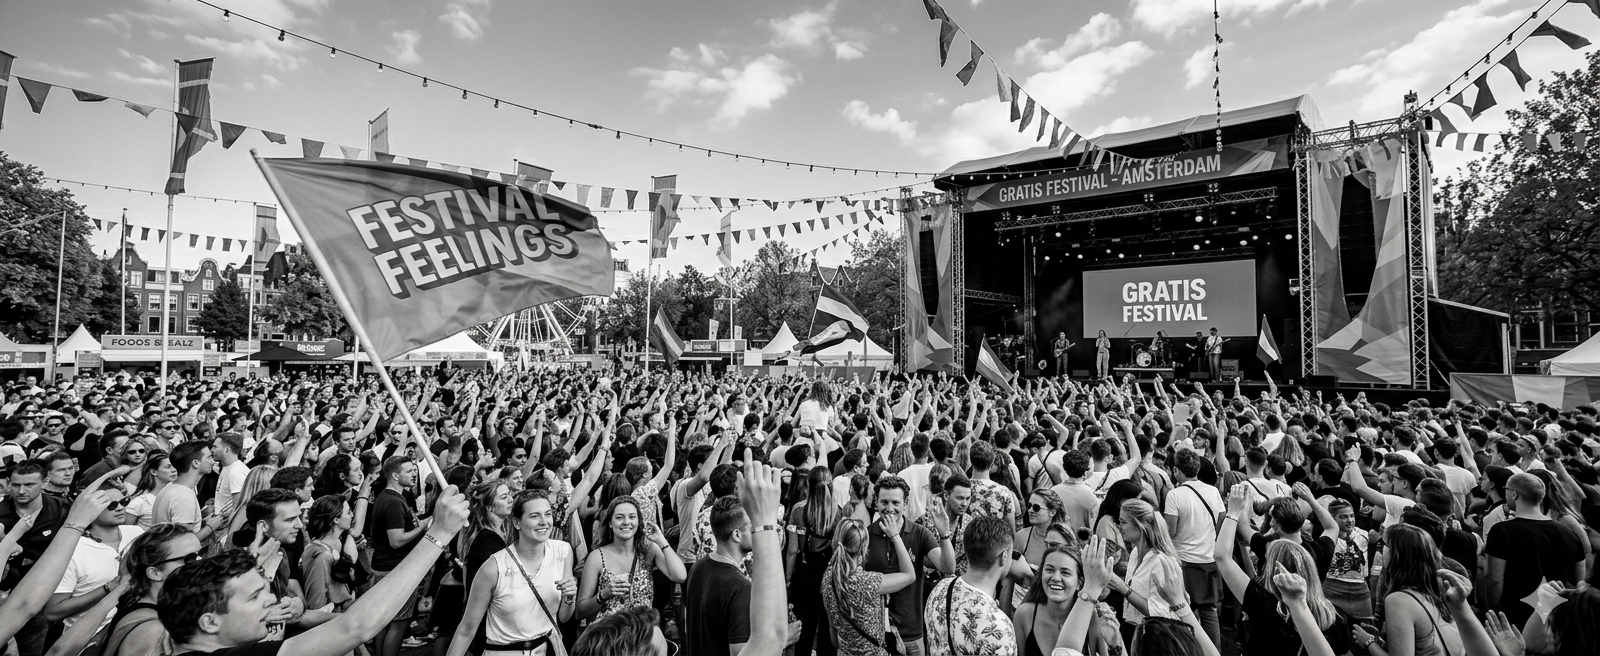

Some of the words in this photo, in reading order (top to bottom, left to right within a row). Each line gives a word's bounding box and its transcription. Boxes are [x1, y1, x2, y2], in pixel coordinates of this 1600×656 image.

[1000, 182, 1043, 202] GRATIS
[1046, 173, 1108, 196] FESTIVAL
[1121, 154, 1221, 185] AMSTERDAM
[347, 185, 561, 250] FESTIVAL
[373, 223, 576, 297] FEELINGS
[1122, 278, 1207, 303] GRATIS
[1122, 303, 1208, 323] FESTIVAL
